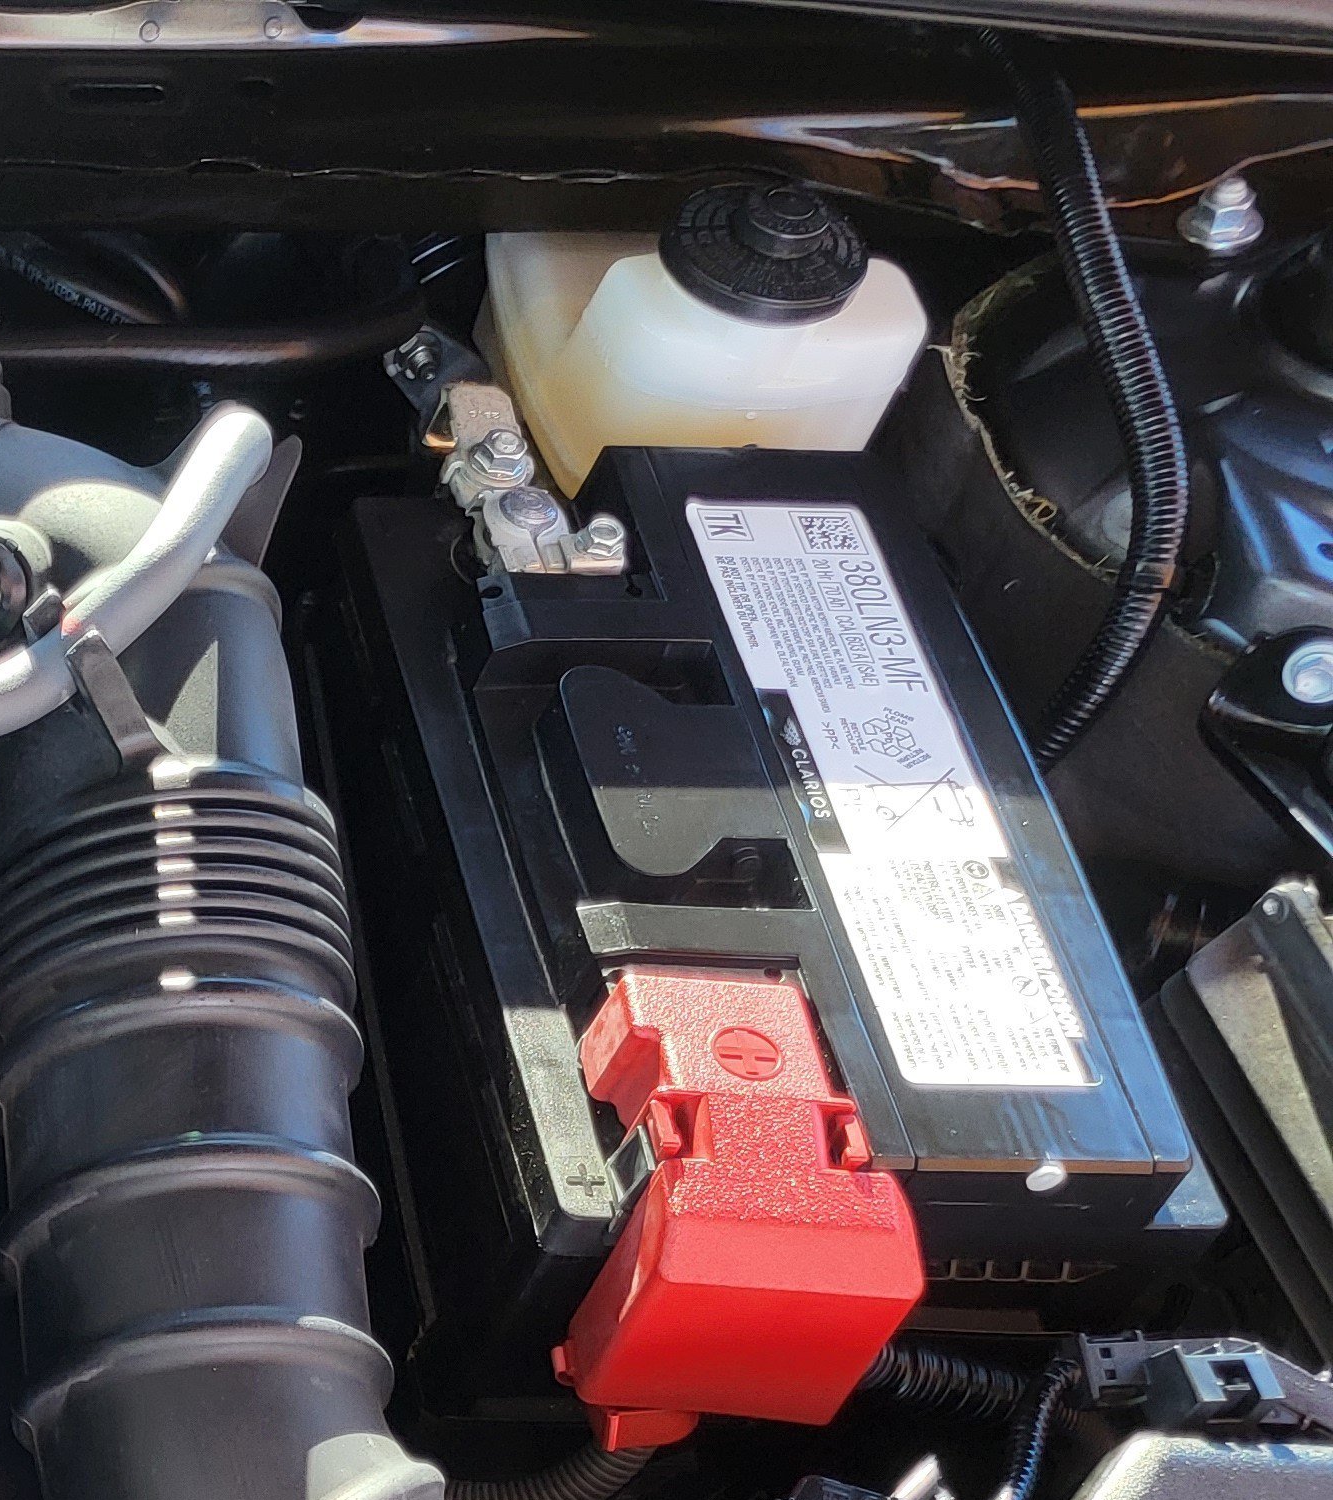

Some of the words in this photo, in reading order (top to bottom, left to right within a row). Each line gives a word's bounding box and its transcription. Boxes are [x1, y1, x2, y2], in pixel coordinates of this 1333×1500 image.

[704, 513, 746, 536] TK
[714, 555, 727, 564] NE
[724, 556, 737, 566] DO
[811, 558, 831, 569] 20
[718, 565, 732, 579] PAS
[728, 566, 743, 580] NOT
[816, 570, 834, 581] Hr
[734, 581, 747, 592] TIP
[822, 585, 842, 596] 70
[724, 579, 744, 610] INCLINER
[738, 593, 751, 603] OR
[826, 596, 846, 608] Ah
[736, 610, 748, 621] OU
[834, 614, 857, 632] CCA
[839, 560, 927, 691] 380LN3-MF
[844, 636, 866, 652] 603
[851, 652, 870, 660] A
[851, 663, 880, 687] (SAE)
[884, 713, 908, 725] LEAD
[839, 717, 860, 755] RECYCLAGE
[849, 722, 867, 751] RECYCLE
[881, 730, 894, 744] Pb
[792, 748, 831, 818] CLARIOS
